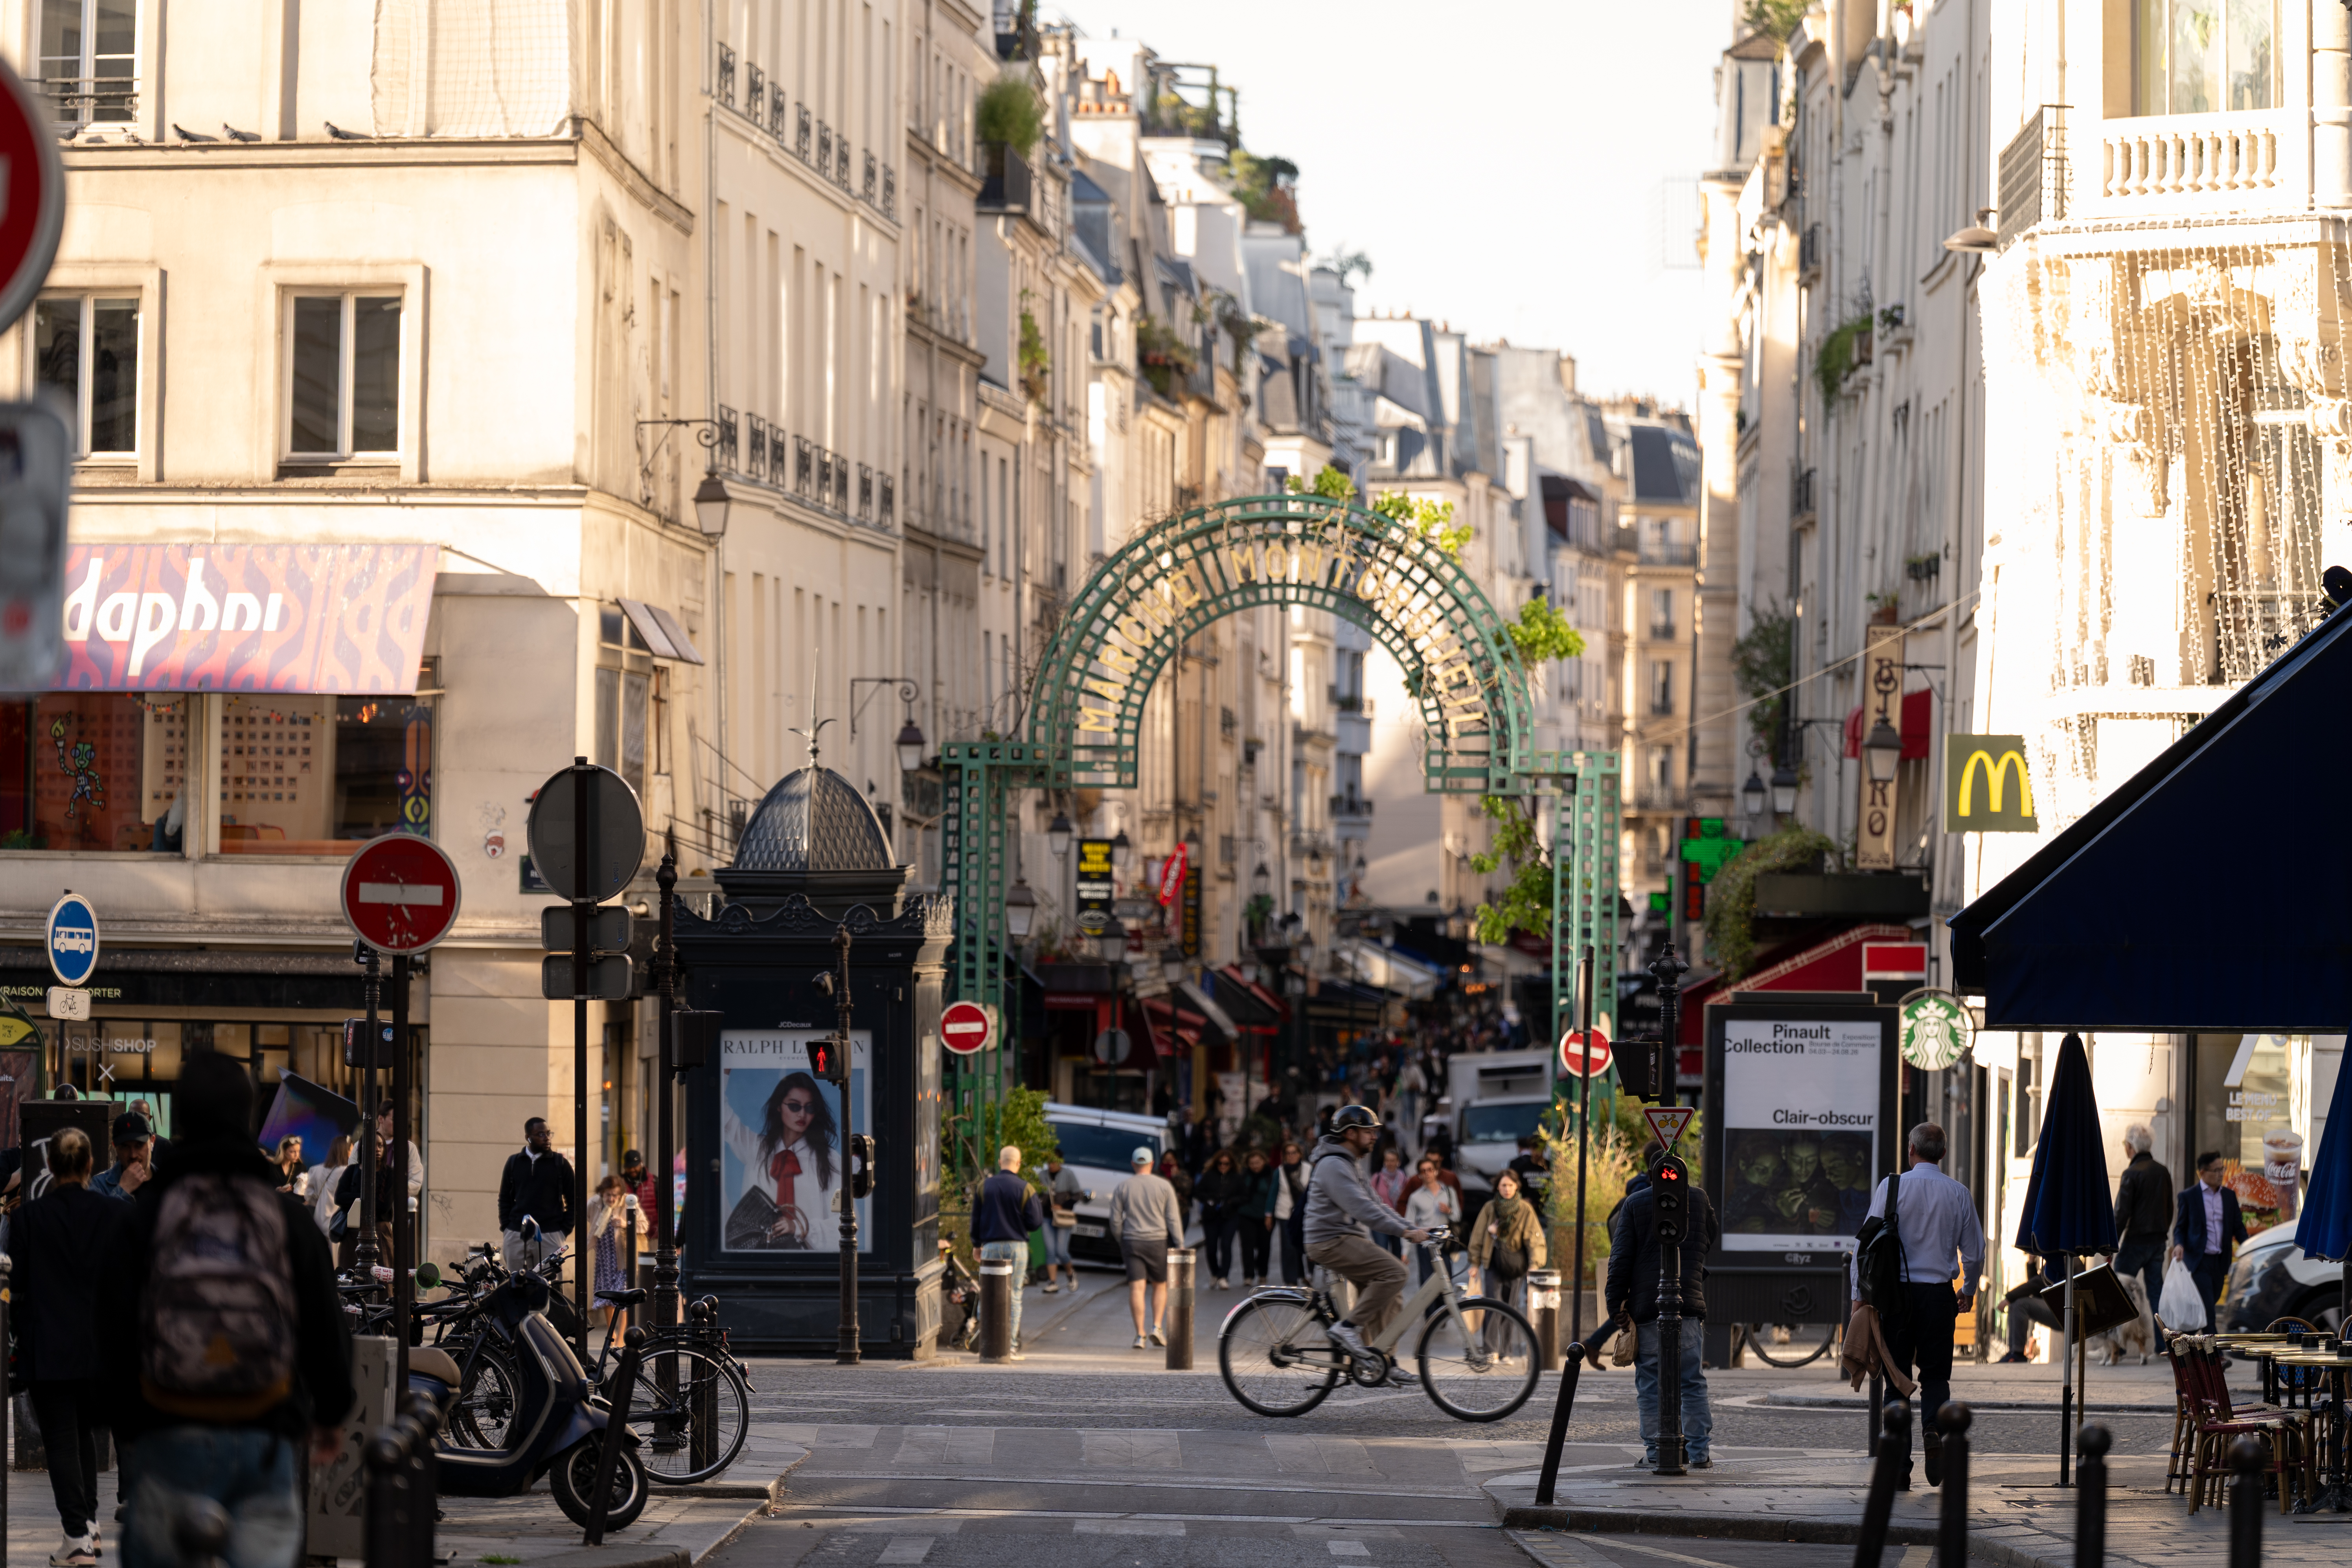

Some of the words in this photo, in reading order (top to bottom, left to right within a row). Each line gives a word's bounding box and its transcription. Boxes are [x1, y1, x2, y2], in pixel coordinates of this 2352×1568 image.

[62, 557, 282, 676] daphni
[1230, 545, 1484, 738] MONTORGUEIL
[0, 986, 42, 996] RAISON
[1773, 1024, 1830, 1040] Pinault
[724, 1040, 783, 1054] RALPH
[1725, 1038, 1804, 1054] Collection
[2229, 1091, 2242, 1106] LE
[2245, 1092, 2277, 1106] MENU
[2226, 1107, 2254, 1122] BEST
[1785, 1253, 1811, 1265] Cityz
